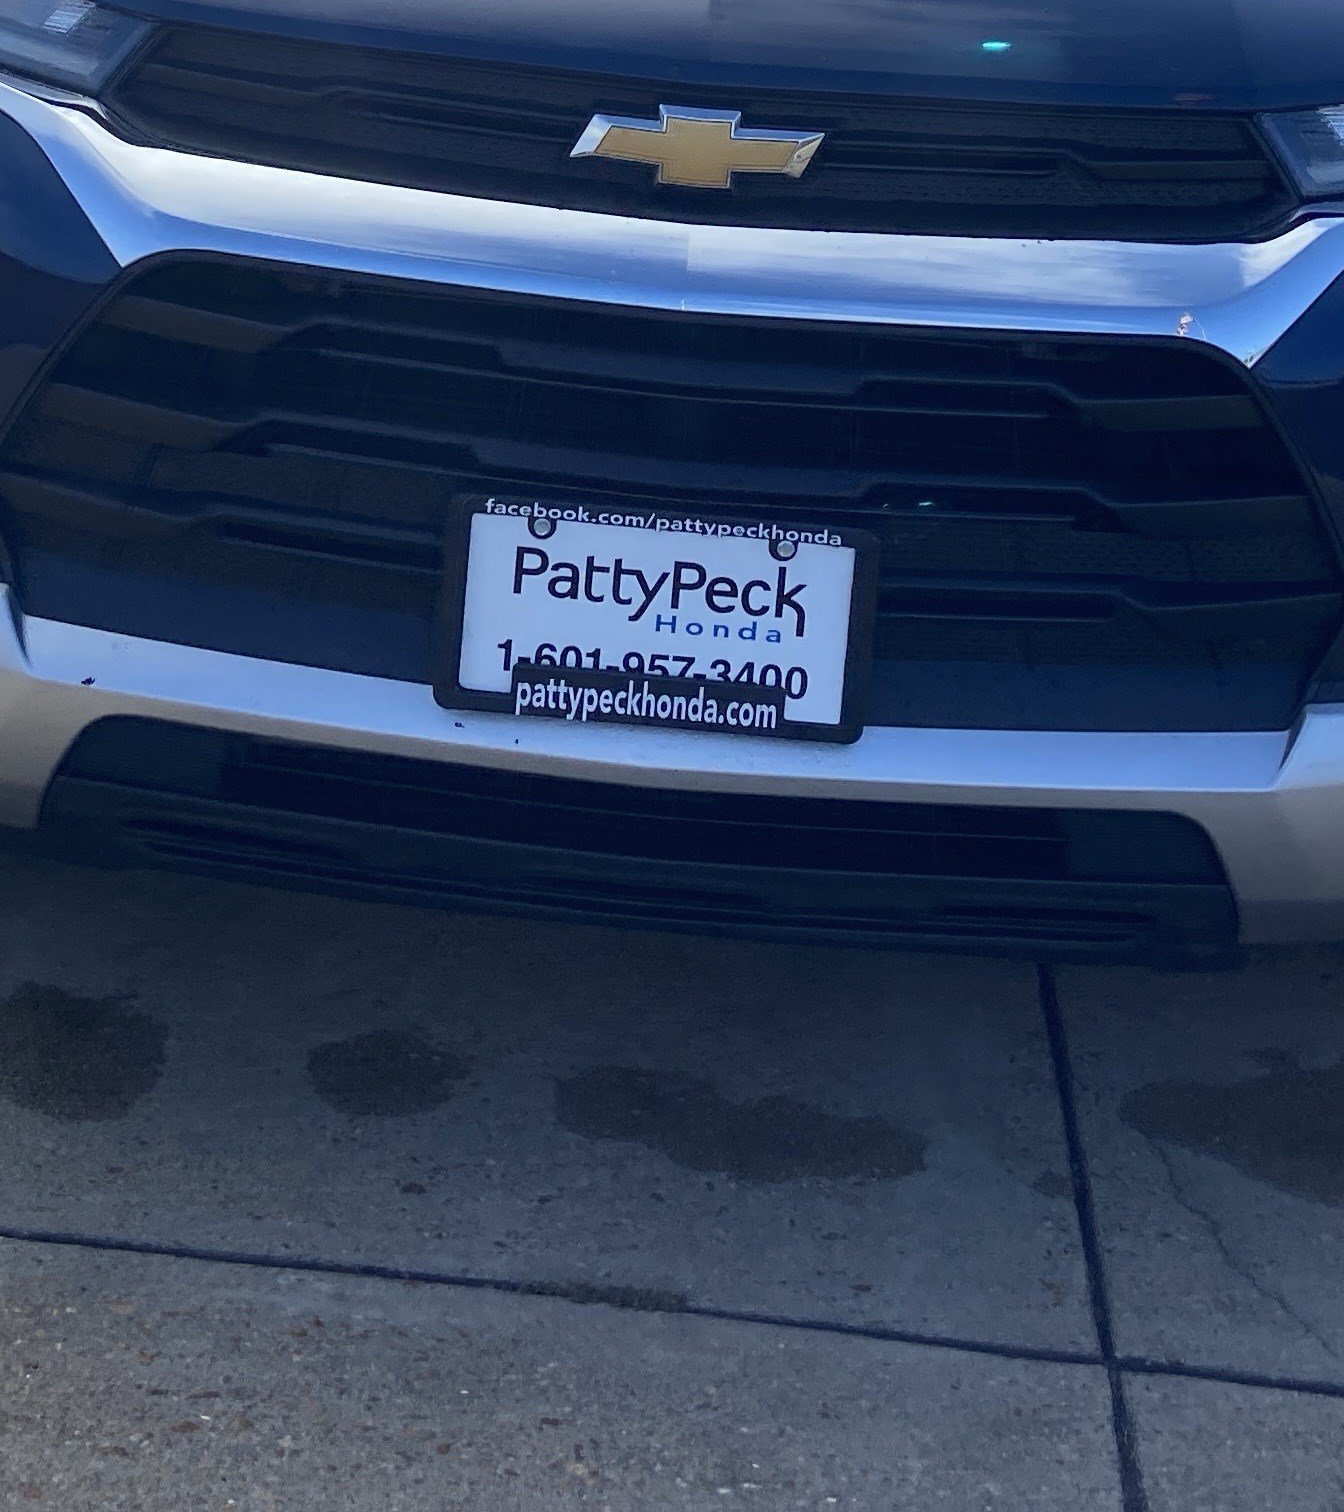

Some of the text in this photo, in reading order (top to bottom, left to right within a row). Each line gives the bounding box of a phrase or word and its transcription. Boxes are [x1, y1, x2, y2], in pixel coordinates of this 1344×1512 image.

[485, 497, 843, 547] facebook.com/pattypeckhonda
[512, 545, 808, 638] PattyPeck
[655, 614, 782, 644] Honda
[514, 678, 777, 729] pattypeckhonda.com
